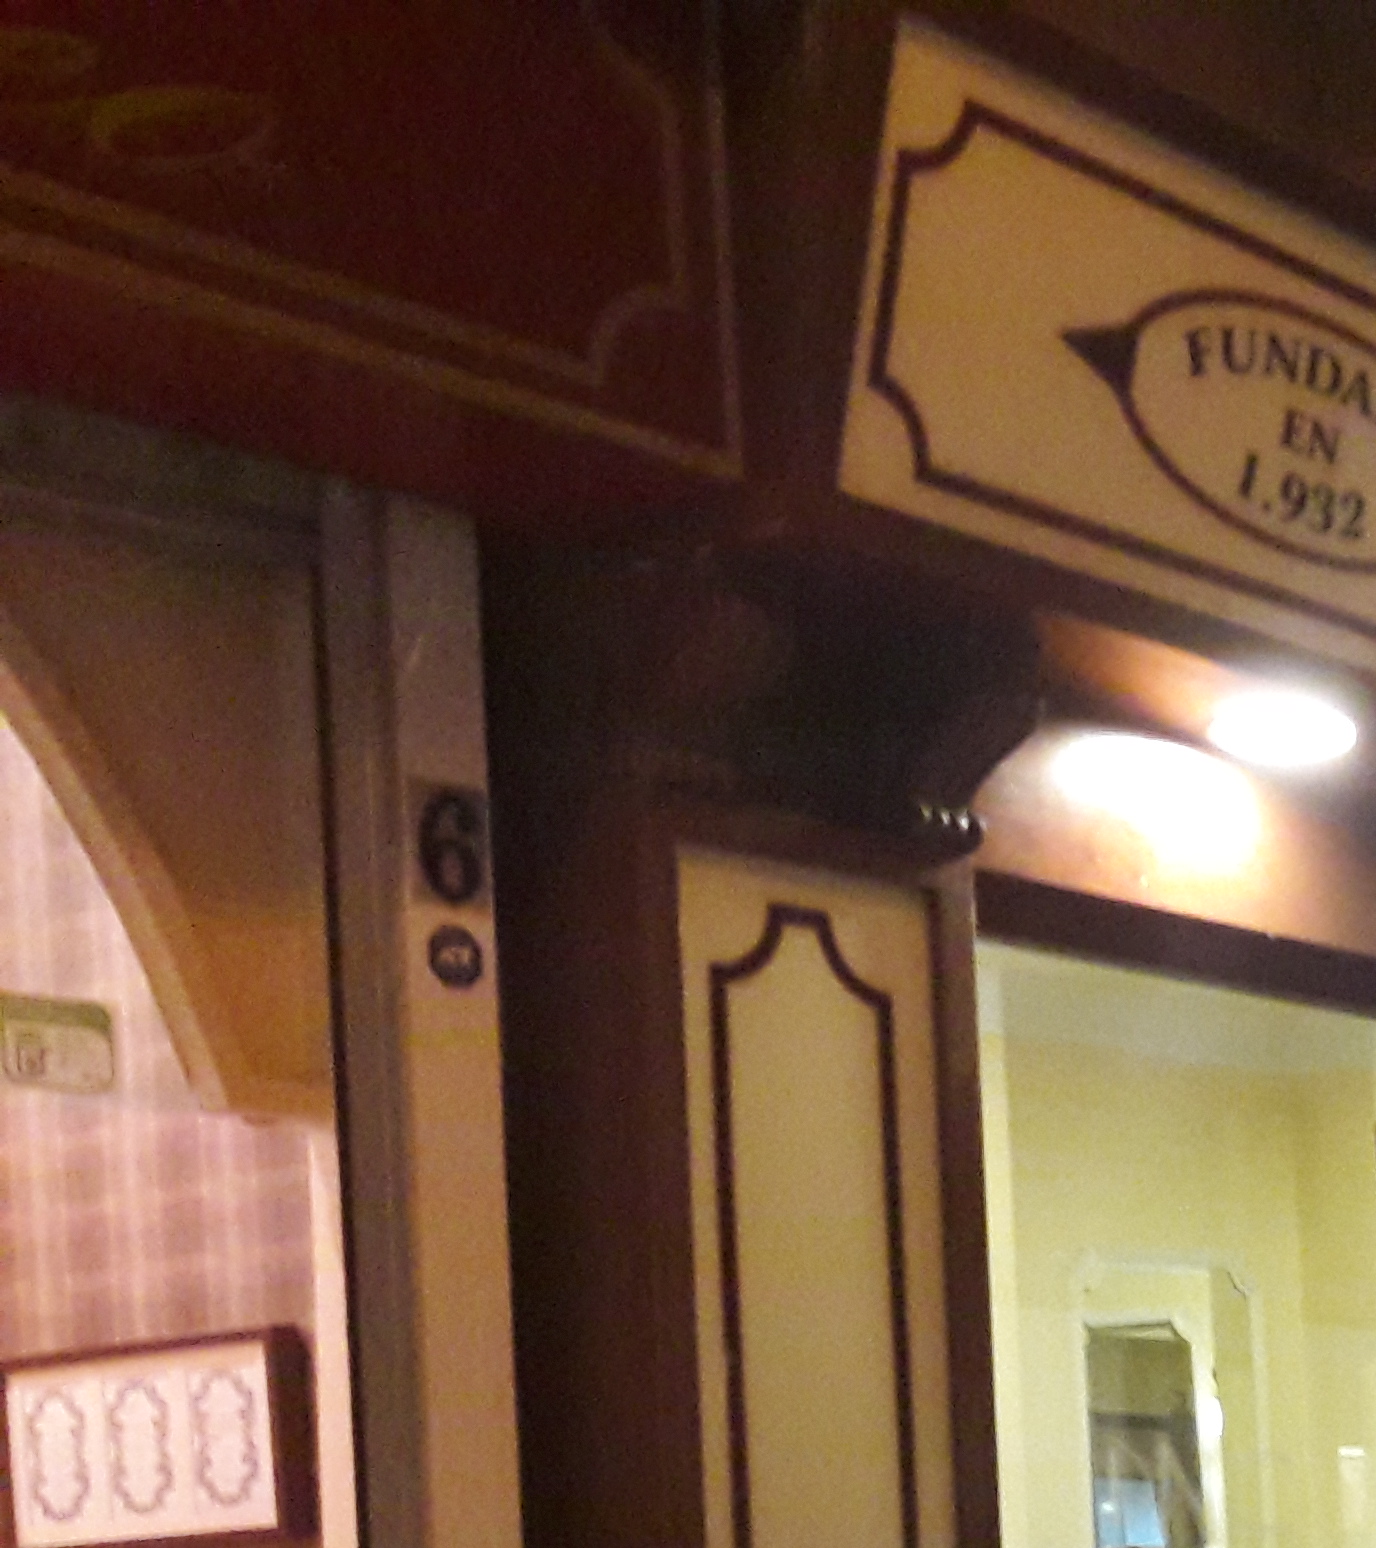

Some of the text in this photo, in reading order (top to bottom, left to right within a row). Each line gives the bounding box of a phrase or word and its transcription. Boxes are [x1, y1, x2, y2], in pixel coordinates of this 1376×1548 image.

[1281, 408, 1341, 465] EN
[1237, 453, 1366, 541] 1.932
[418, 792, 482, 905] 6
